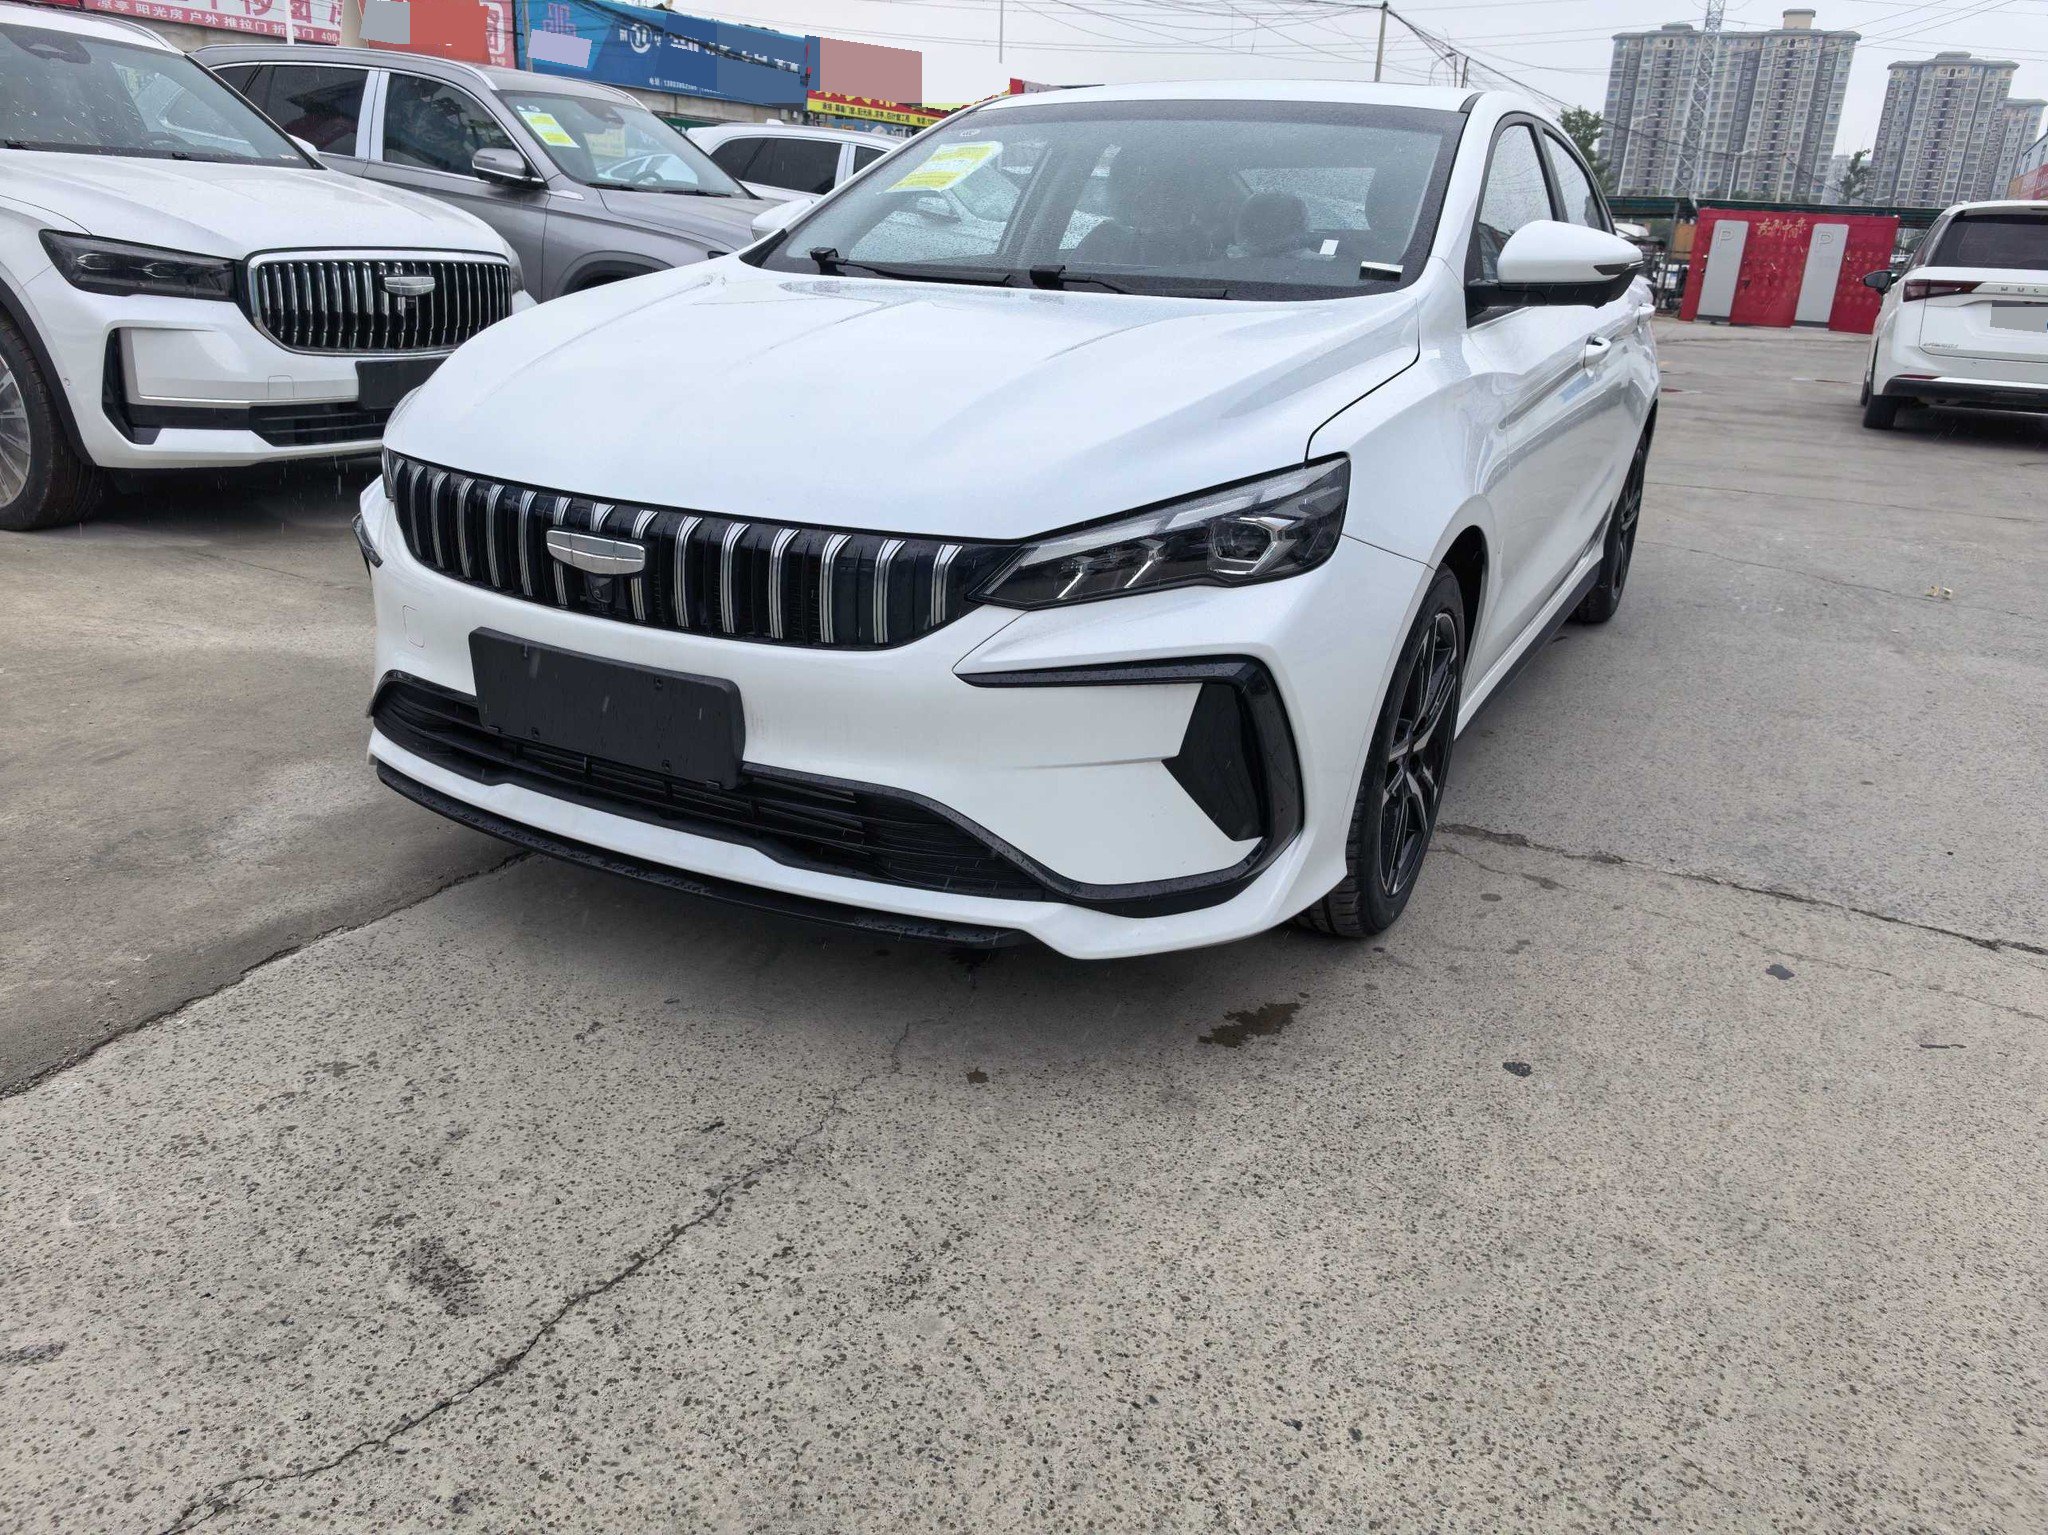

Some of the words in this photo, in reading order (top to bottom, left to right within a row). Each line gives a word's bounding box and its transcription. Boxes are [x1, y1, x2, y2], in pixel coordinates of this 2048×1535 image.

[135, 3, 184, 20] 阳光房
[190, 12, 218, 26] 户外
[223, 16, 268, 32] 推拉门
